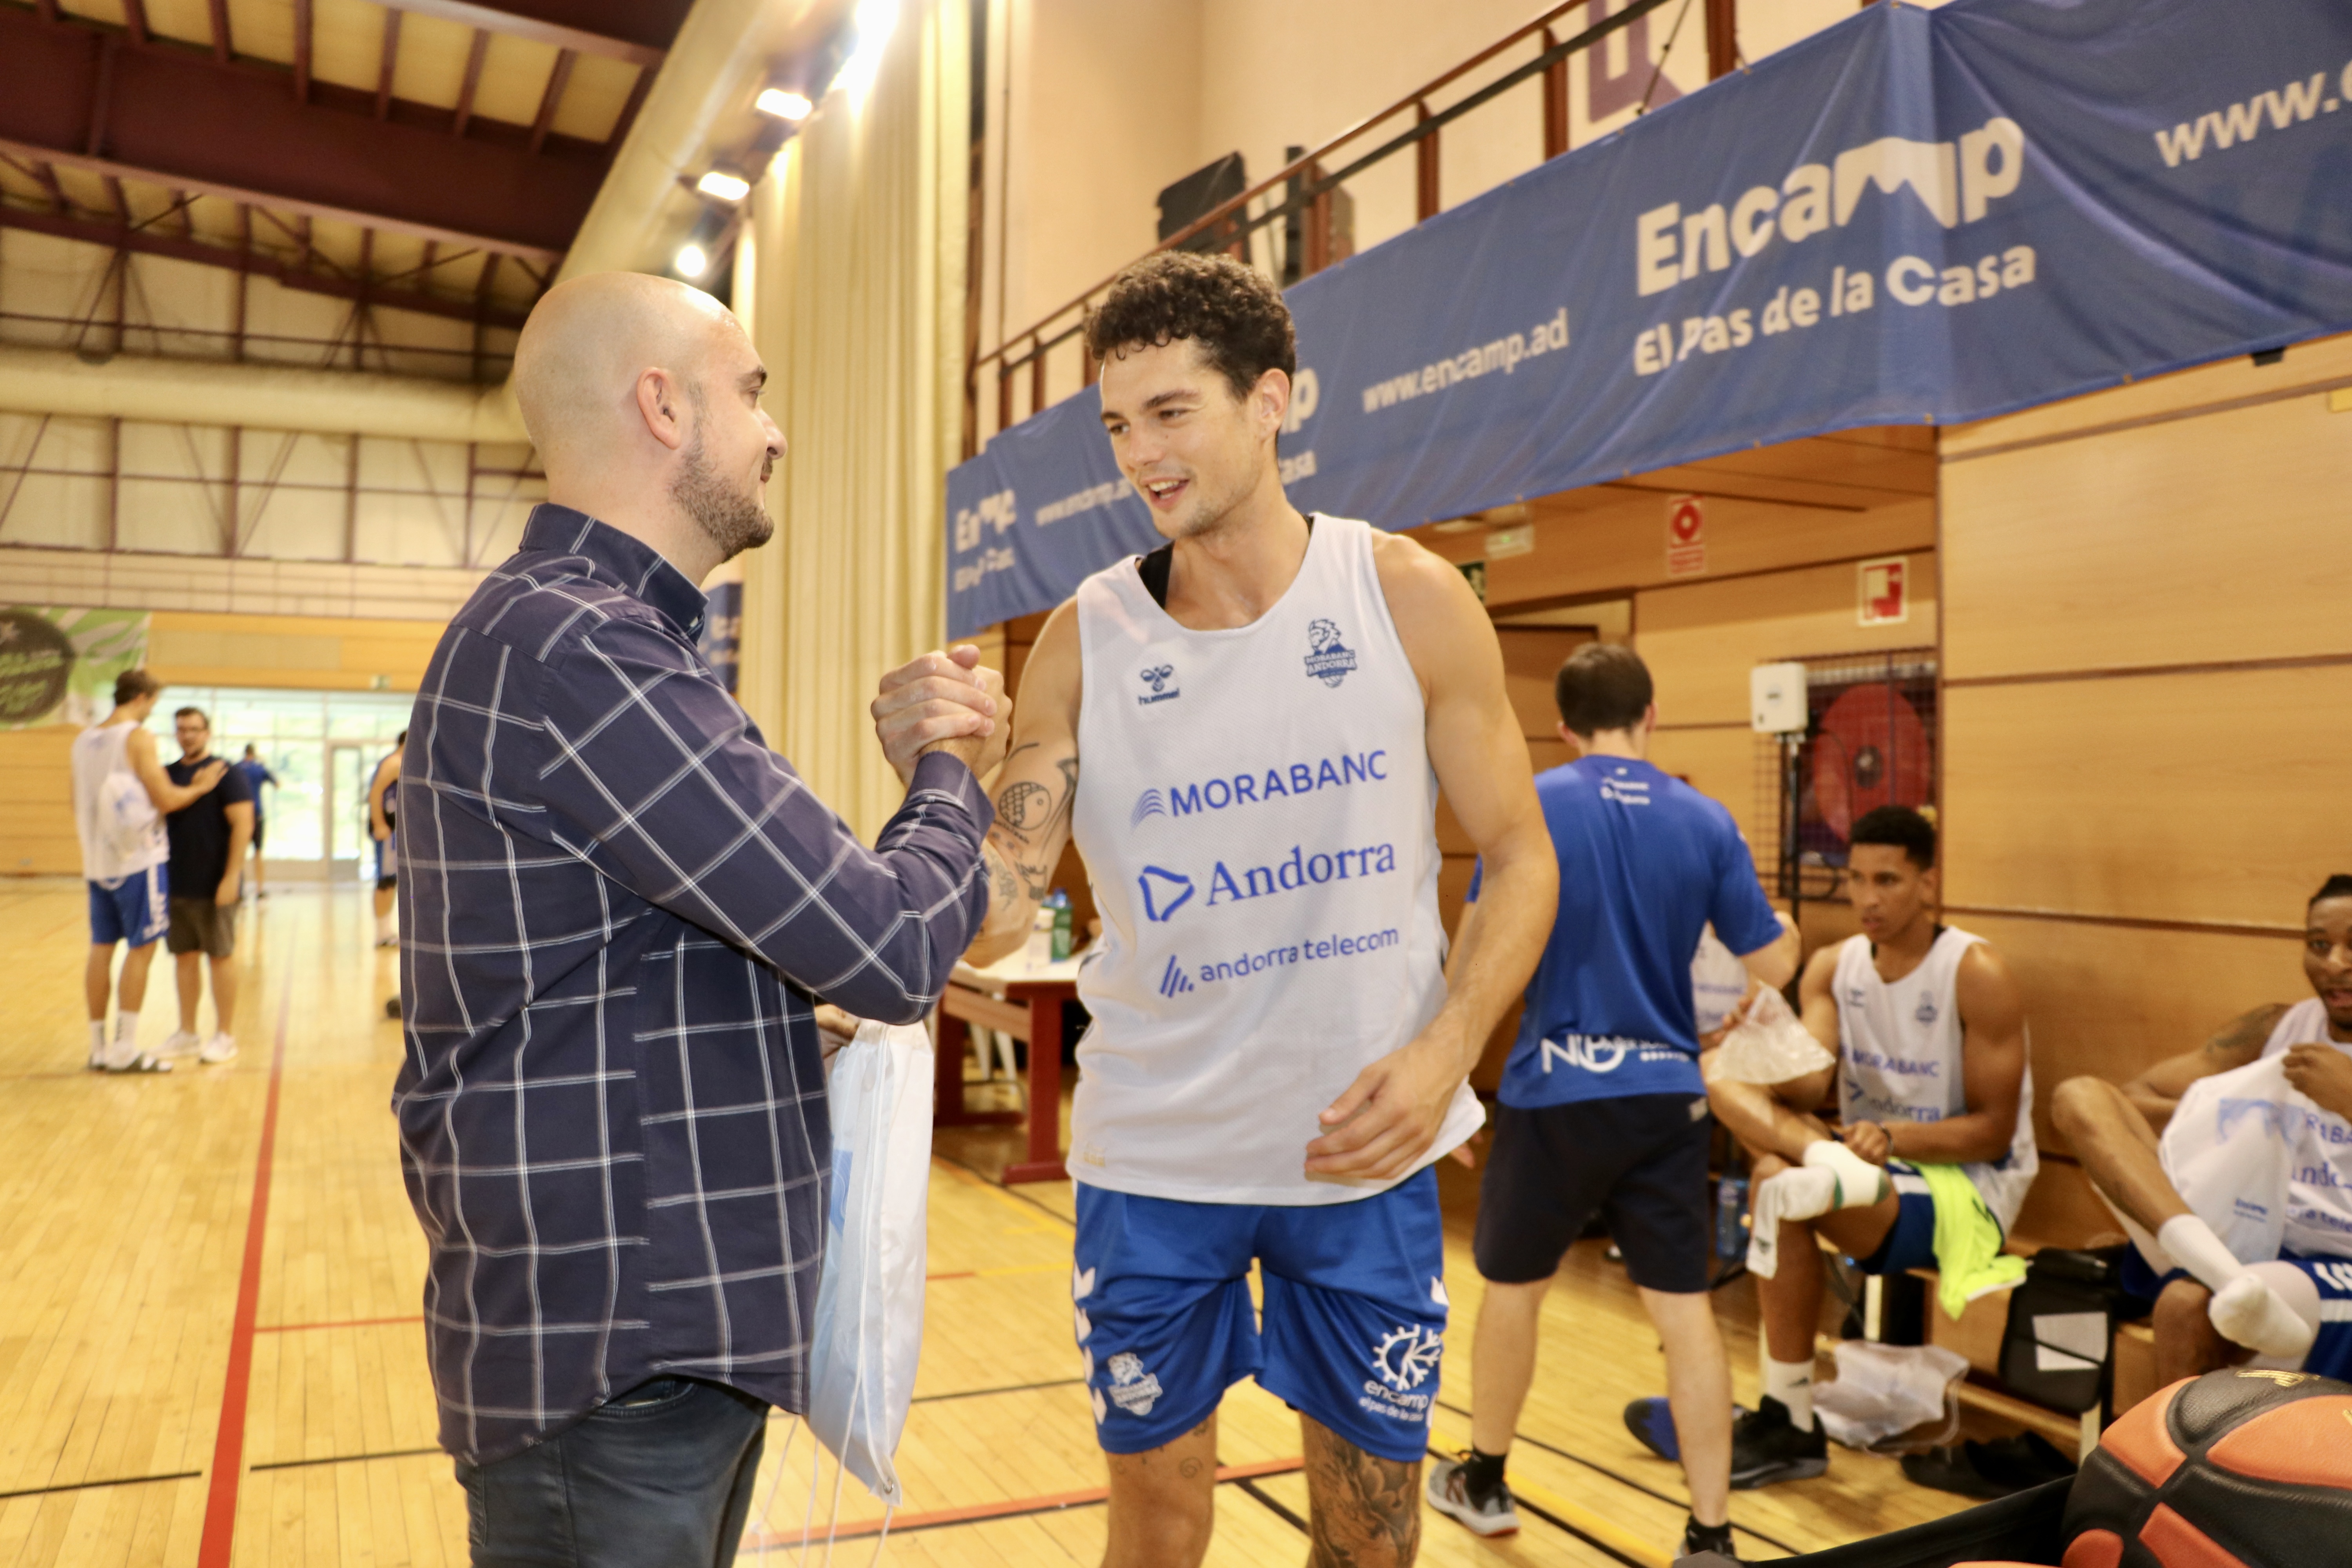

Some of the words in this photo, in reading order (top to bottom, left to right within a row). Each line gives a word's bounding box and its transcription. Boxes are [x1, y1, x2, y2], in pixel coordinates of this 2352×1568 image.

[1637, 118, 2025, 296] Encamp
[1634, 323, 1674, 376] El
[1677, 308, 1753, 362] Pas
[1761, 285, 1821, 336] de
[1829, 265, 1874, 317] la
[1885, 245, 2036, 307] Casa
[1362, 307, 1569, 414] www.encamp.ad
[1170, 750, 1387, 817] MORABANC
[1206, 843, 1396, 906] Andorra
[1200, 946, 1299, 982] andorra
[1303, 928, 1399, 960] telecom
[1364, 1380, 1429, 1411] encamp
